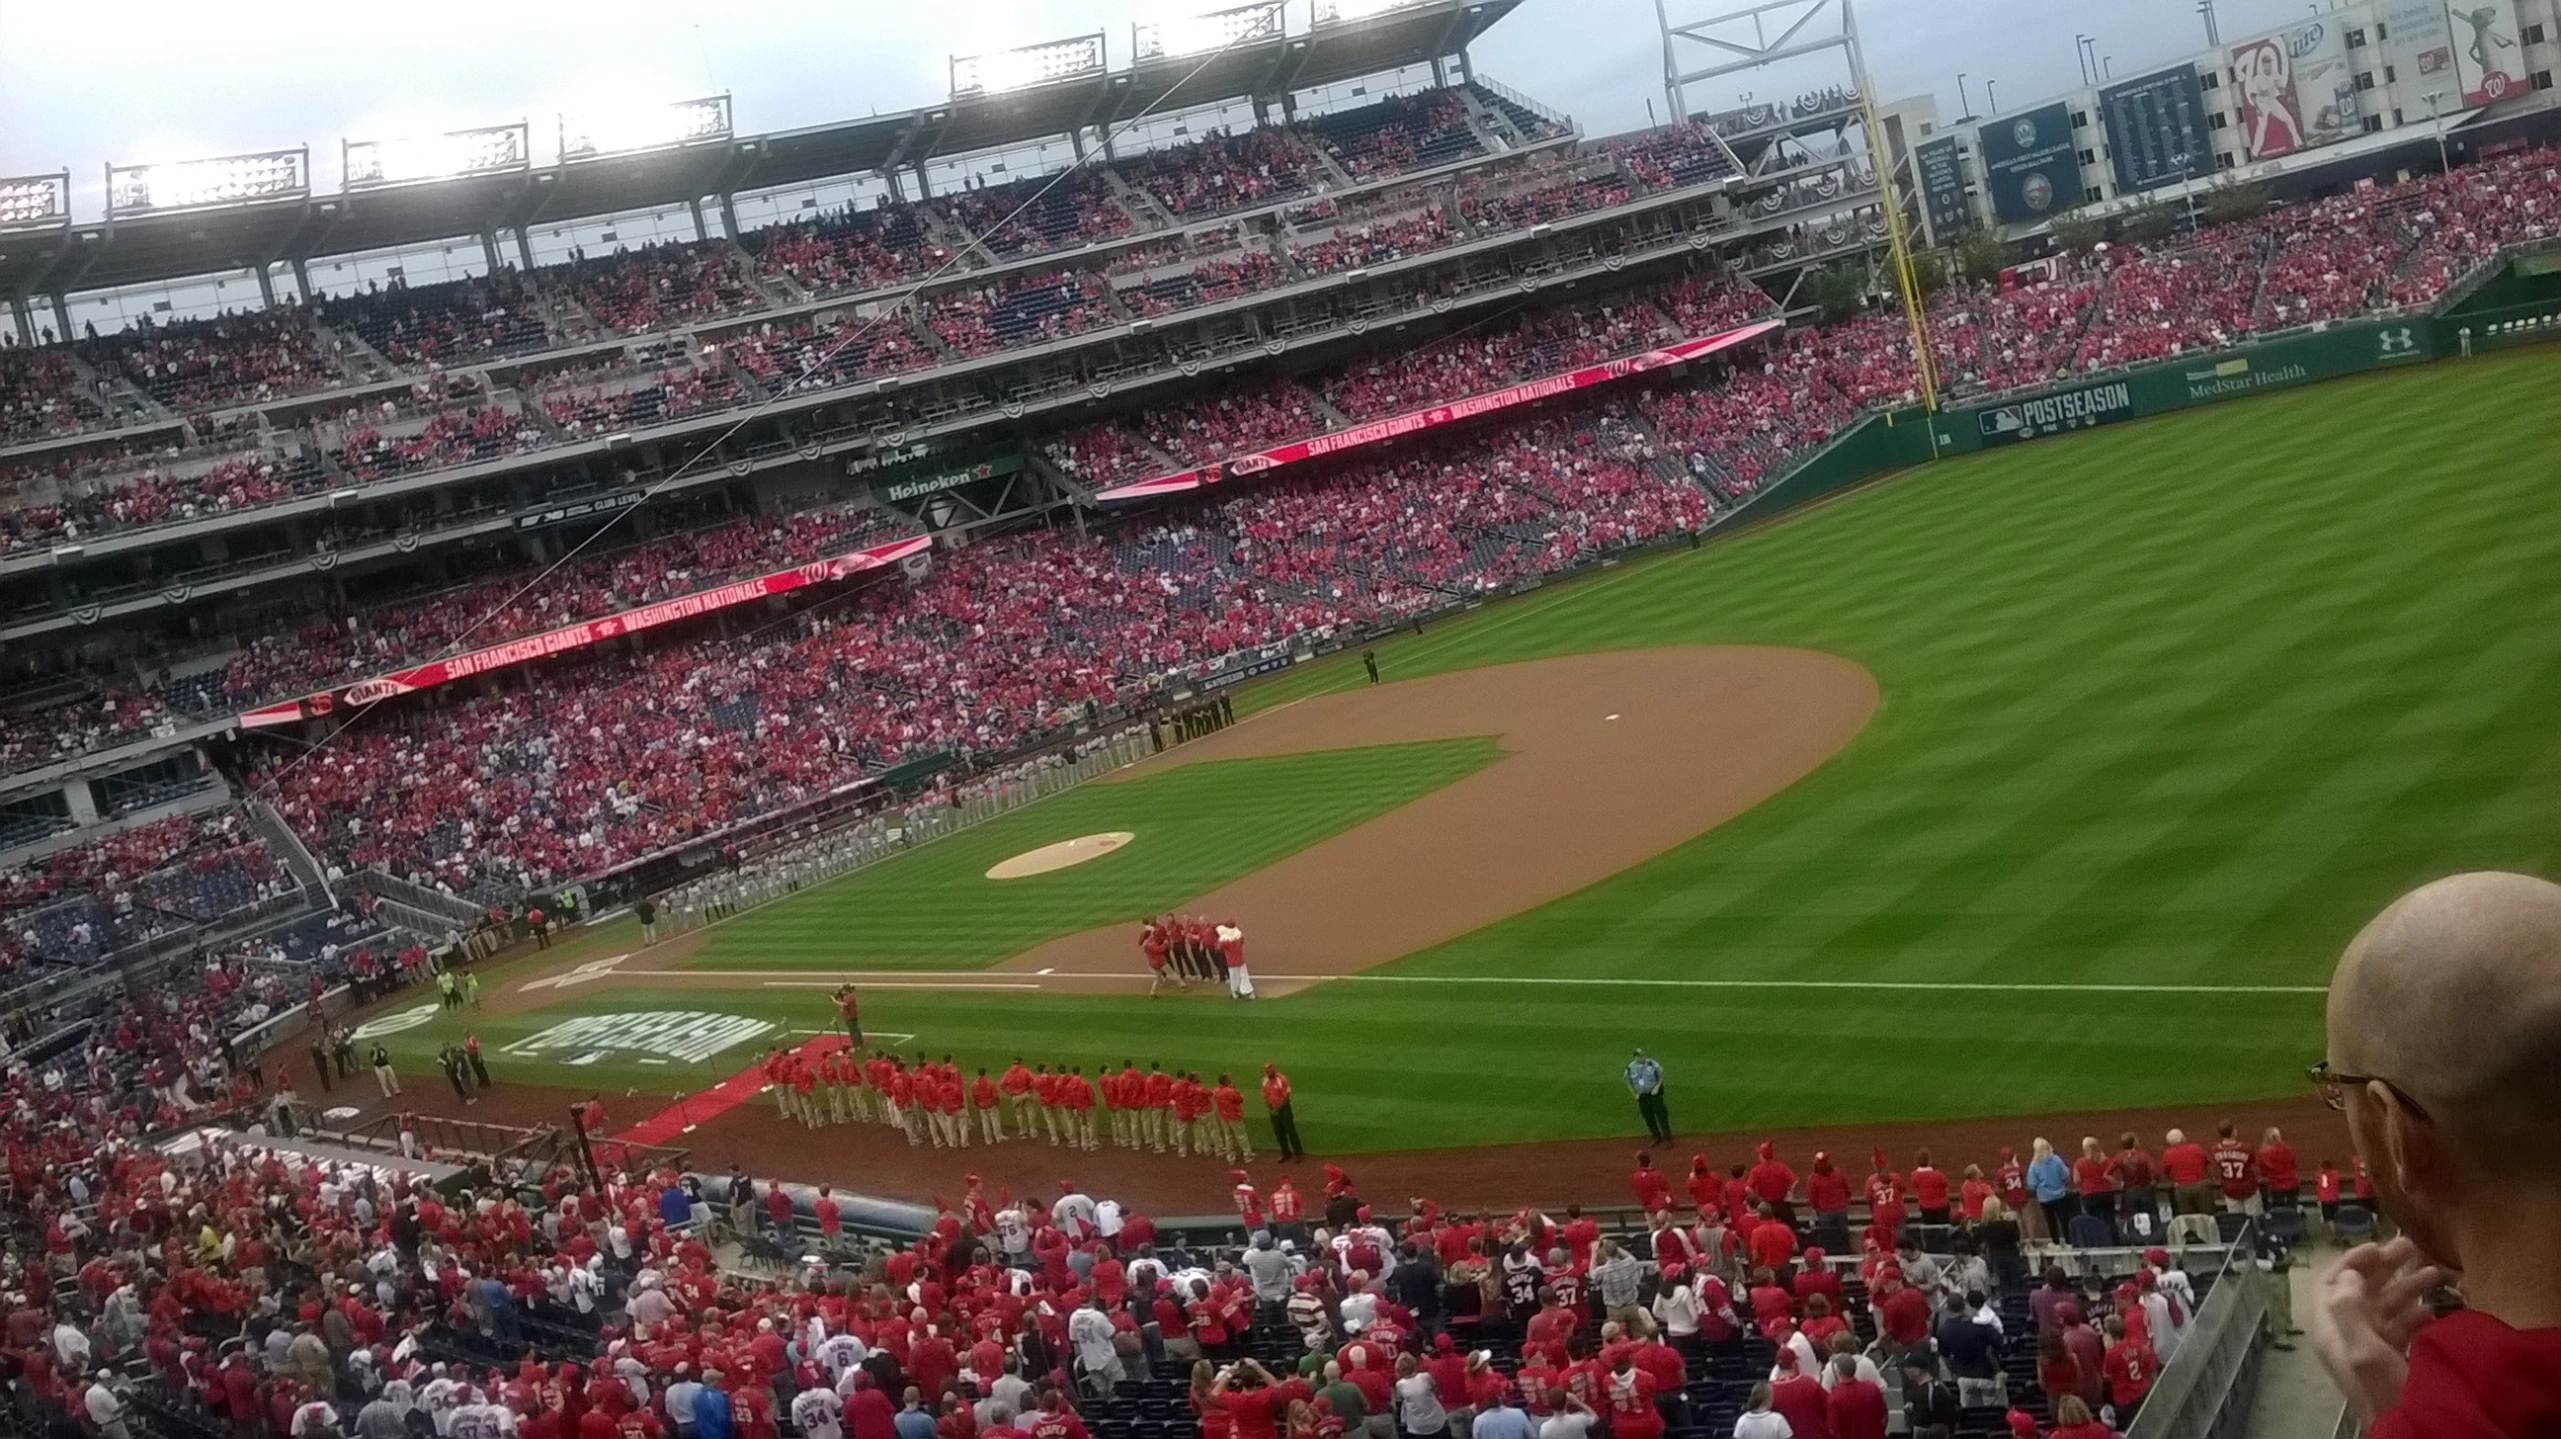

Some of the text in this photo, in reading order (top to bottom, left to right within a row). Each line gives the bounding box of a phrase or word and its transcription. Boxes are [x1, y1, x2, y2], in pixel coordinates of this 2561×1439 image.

[2188, 363, 2307, 399] MedStar Health
[1449, 388, 1520, 420] WASHINGTON
[1519, 374, 1576, 404] NATIONALS
[2022, 382, 2131, 426] POSTSEASON
[1306, 413, 1427, 456] SAN FRANCISCO GIANTS
[887, 468, 972, 501] Heineken
[594, 492, 642, 511] CLUB LEVEL
[621, 594, 702, 632] WASHINGTON
[702, 579, 768, 612] NATIONALS
[444, 625, 592, 680] SAN FRANCISCO GIANTS
[350, 680, 399, 705] GIANTS
[2220, 1162, 2245, 1179] 37
[2005, 1177, 2022, 1191] 34
[1875, 1187, 1894, 1206] 37
[684, 1283, 700, 1299] 34
[1511, 1283, 1536, 1305] 34
[1555, 1286, 1578, 1308] 37
[836, 1351, 849, 1367] 6
[2128, 1360, 2142, 1381] 2
[804, 1408, 830, 1430] 34
